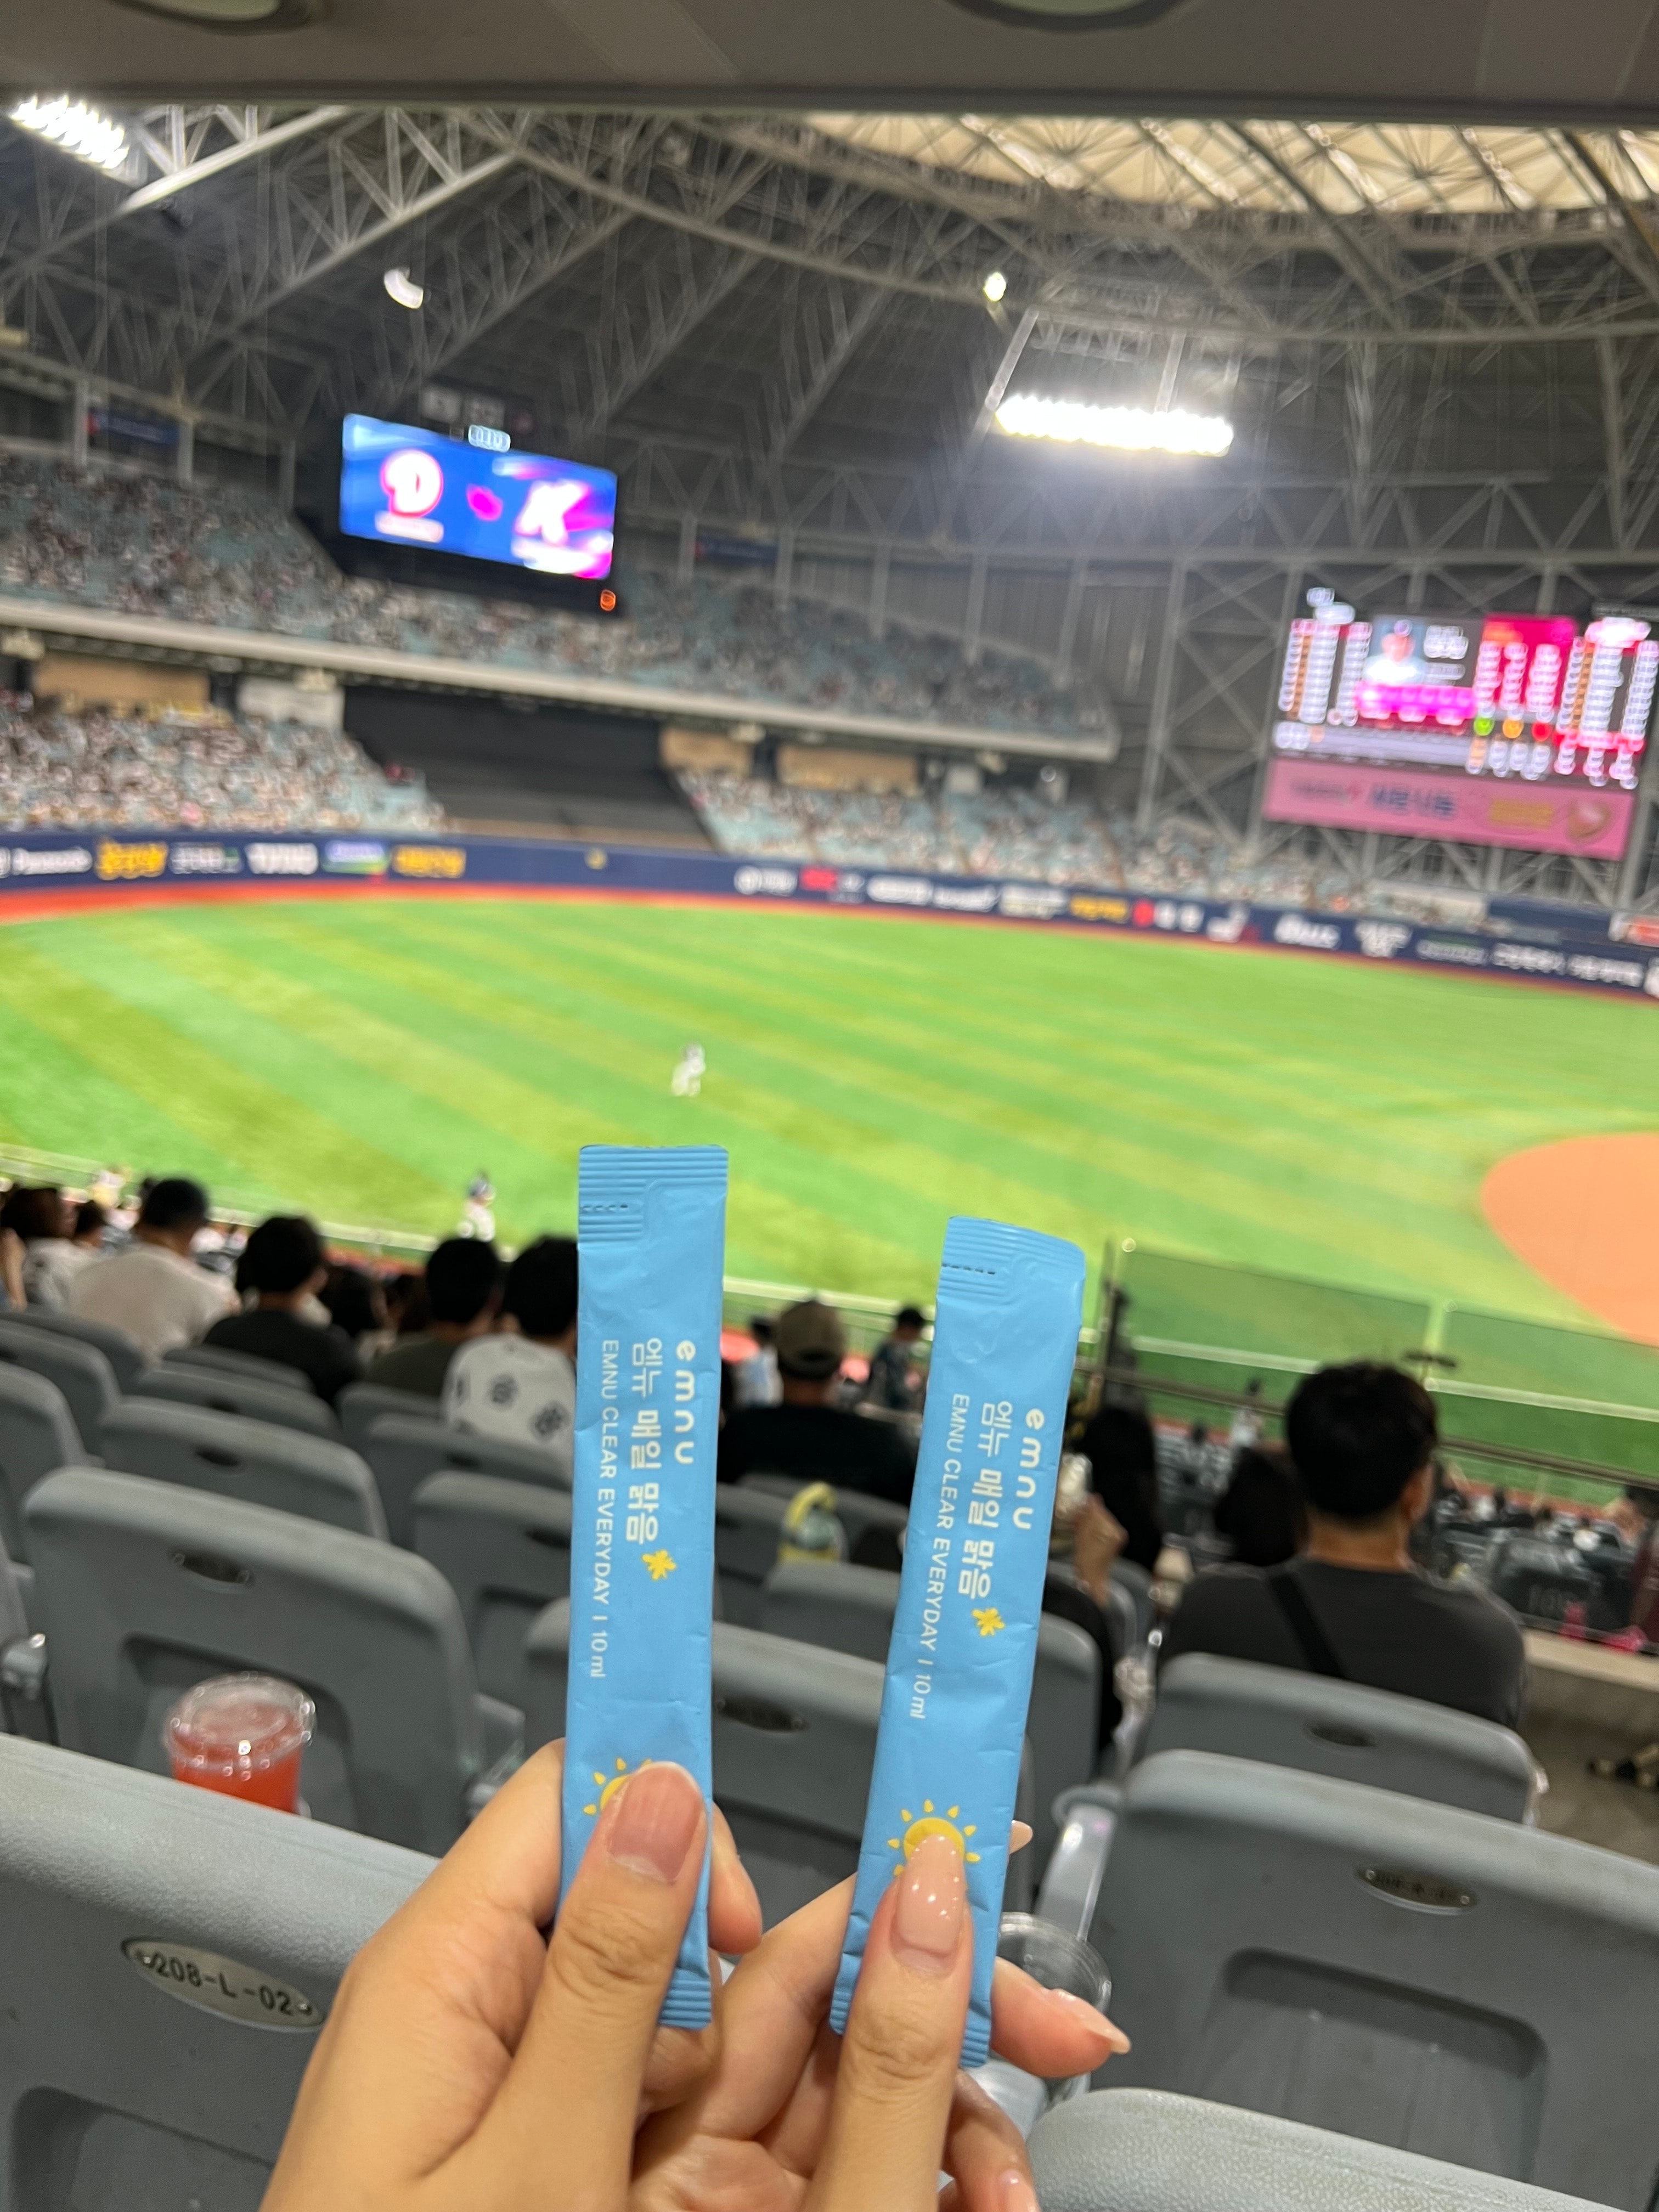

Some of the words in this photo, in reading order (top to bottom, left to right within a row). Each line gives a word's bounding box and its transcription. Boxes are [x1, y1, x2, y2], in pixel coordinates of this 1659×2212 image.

[601, 1340, 619, 1400] EMNU
[631, 1338, 663, 1398] 엠뉴
[675, 1340, 696, 1464] emnu
[946, 1393, 970, 1453] EMNU
[978, 1400, 1013, 1457] 엠뉴
[600, 1406, 618, 1479] CLEAR
[630, 1410, 662, 1470] 매일
[1013, 1408, 1045, 1530] emnu
[625, 1483, 659, 1544] 맑음
[936, 1458, 962, 1530] CLEAR
[968, 1469, 1003, 1528] 매일
[594, 1488, 615, 1605] EVERYDAY
[958, 1539, 994, 1599] 맑음
[920, 1537, 951, 1651] EVERYDAY
